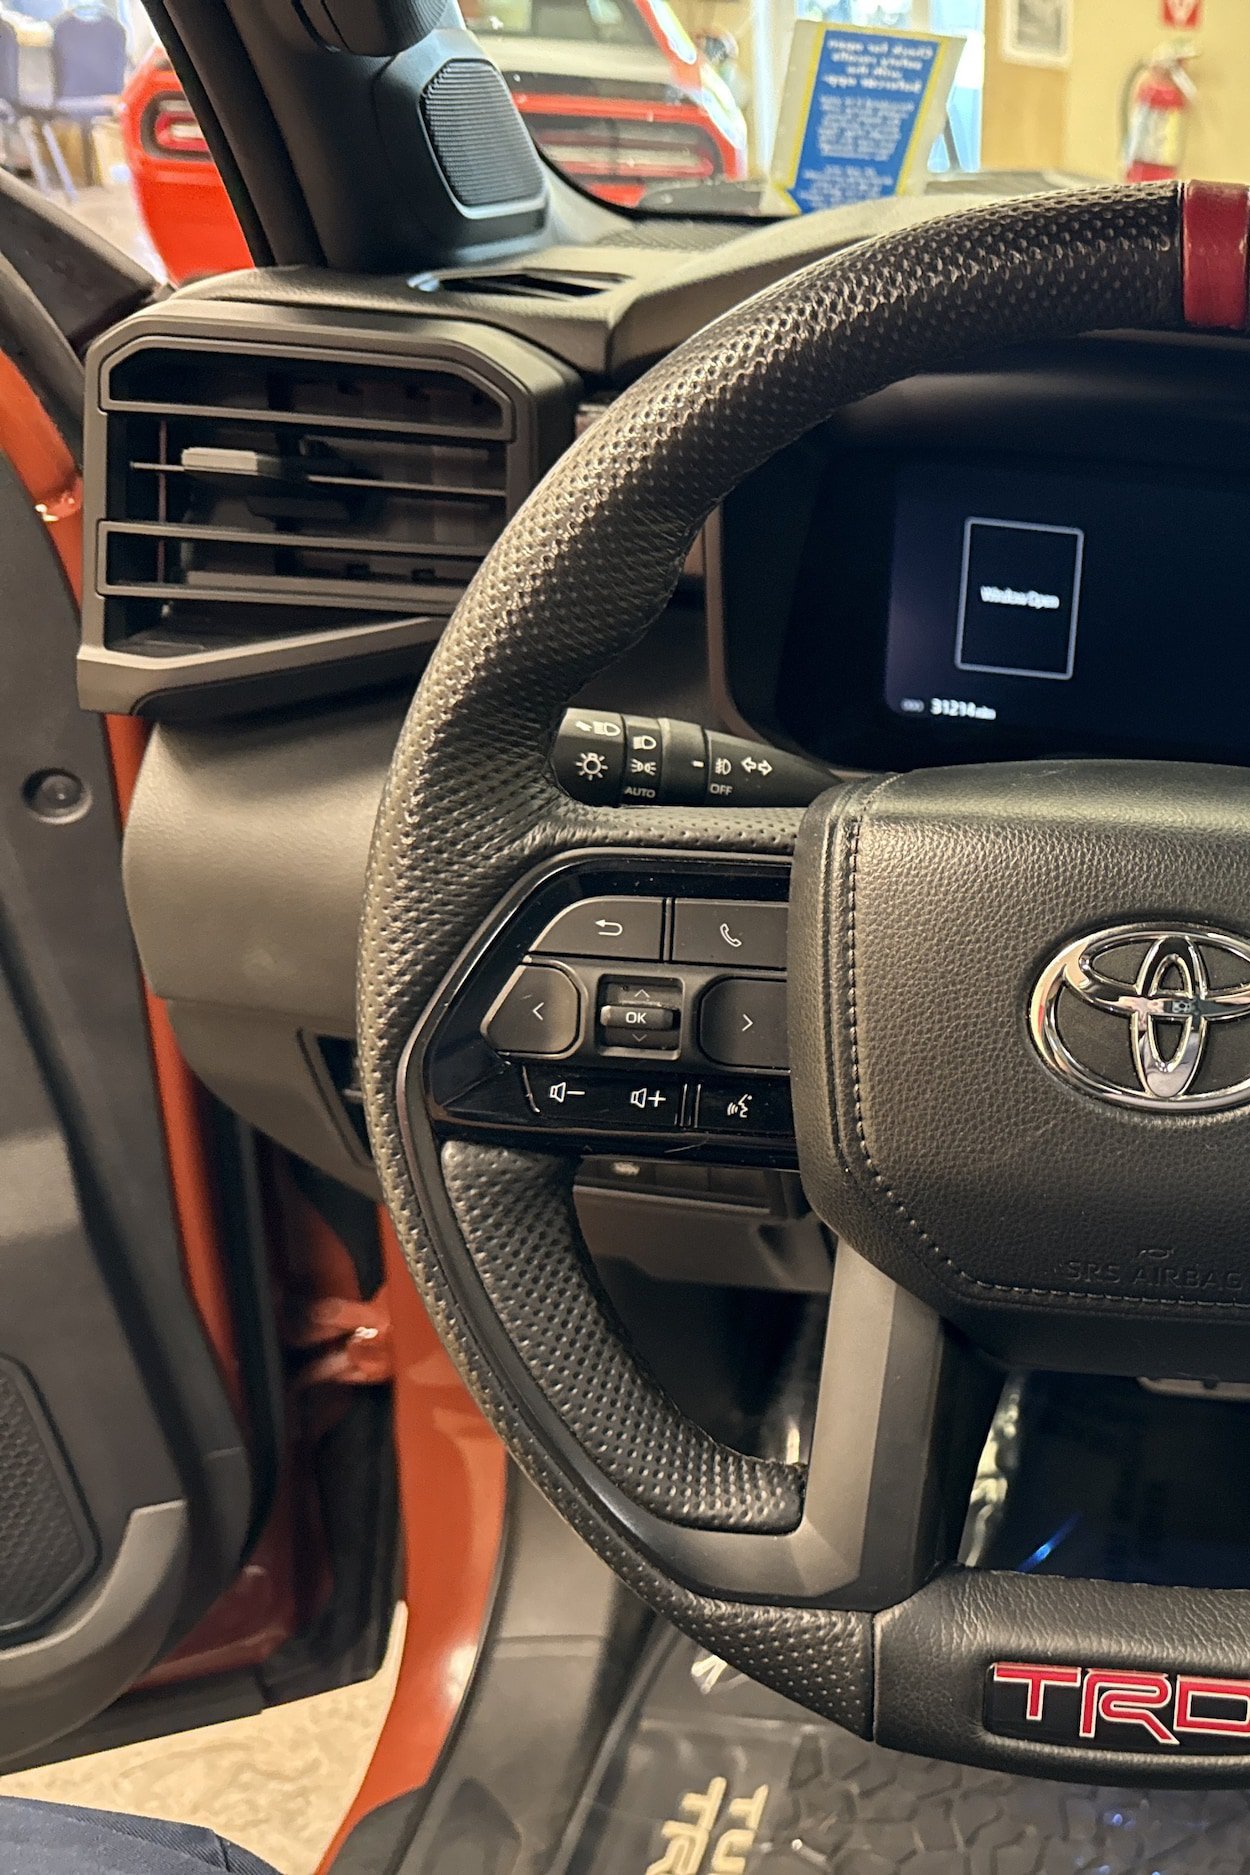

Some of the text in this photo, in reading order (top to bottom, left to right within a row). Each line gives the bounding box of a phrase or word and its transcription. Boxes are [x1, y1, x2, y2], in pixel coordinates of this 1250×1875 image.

[624, 787, 656, 799] AUTO
[709, 783, 733, 796] OFF
[625, 1011, 647, 1024] OK
[1064, 1261, 1243, 1292] SRS AIRBAG
